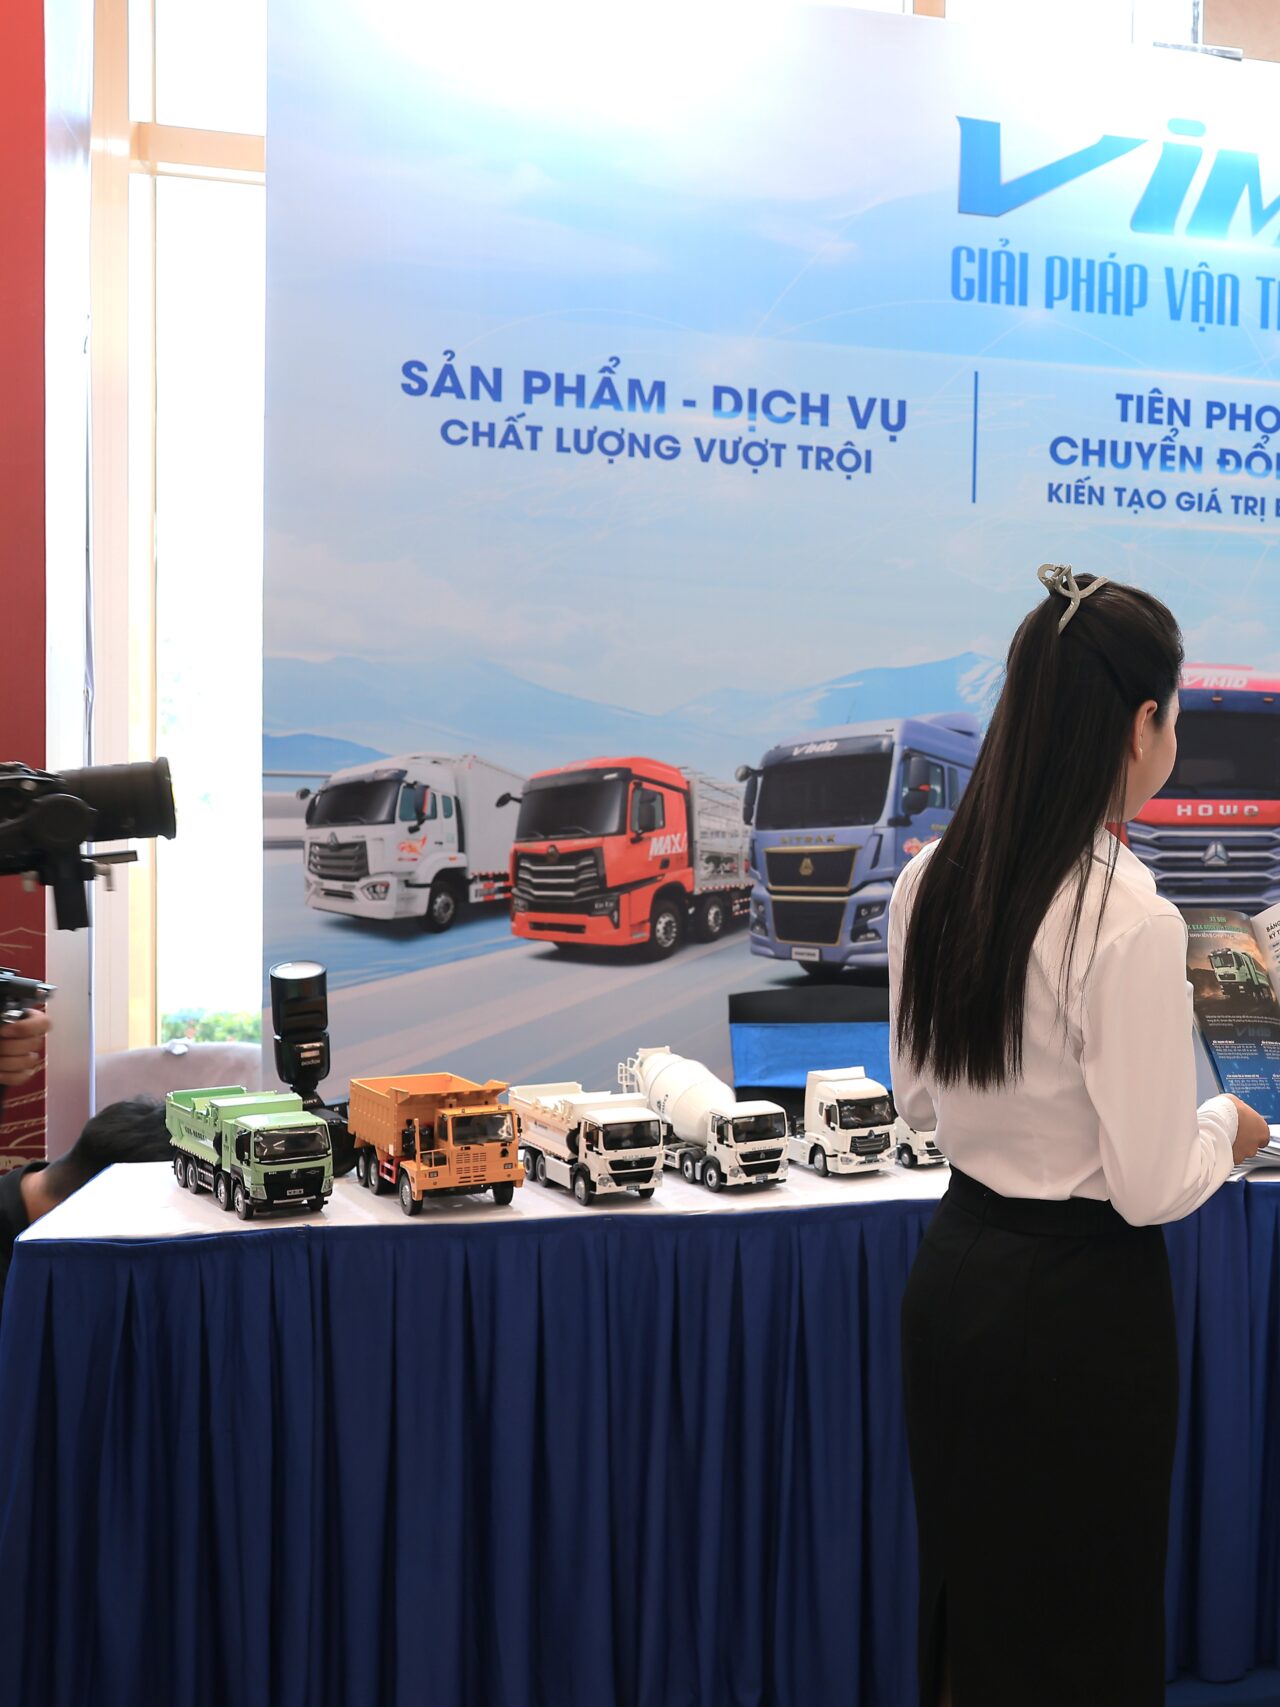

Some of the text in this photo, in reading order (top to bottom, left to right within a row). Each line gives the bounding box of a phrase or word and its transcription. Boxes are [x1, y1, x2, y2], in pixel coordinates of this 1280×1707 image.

[950, 237, 1029, 307] GIẢI
[1044, 252, 1149, 317] PHÁP
[1164, 261, 1240, 332] VẬN
[400, 349, 503, 403] SẢN
[522, 355, 667, 414] PHẨM
[712, 385, 830, 433] DỊCH
[846, 395, 907, 443] VỤ
[1115, 387, 1191, 428] TIÊN
[439, 411, 872, 481] CHẤT LƯỢNG VƯỢT TRỘI
[1048, 427, 1203, 475] CHUYỂN
[1047, 476, 1105, 506] KIẾN
[1114, 487, 1167, 514] TẠO
[1175, 487, 1222, 514] GIÁ
[1230, 494, 1266, 522] TRỊ
